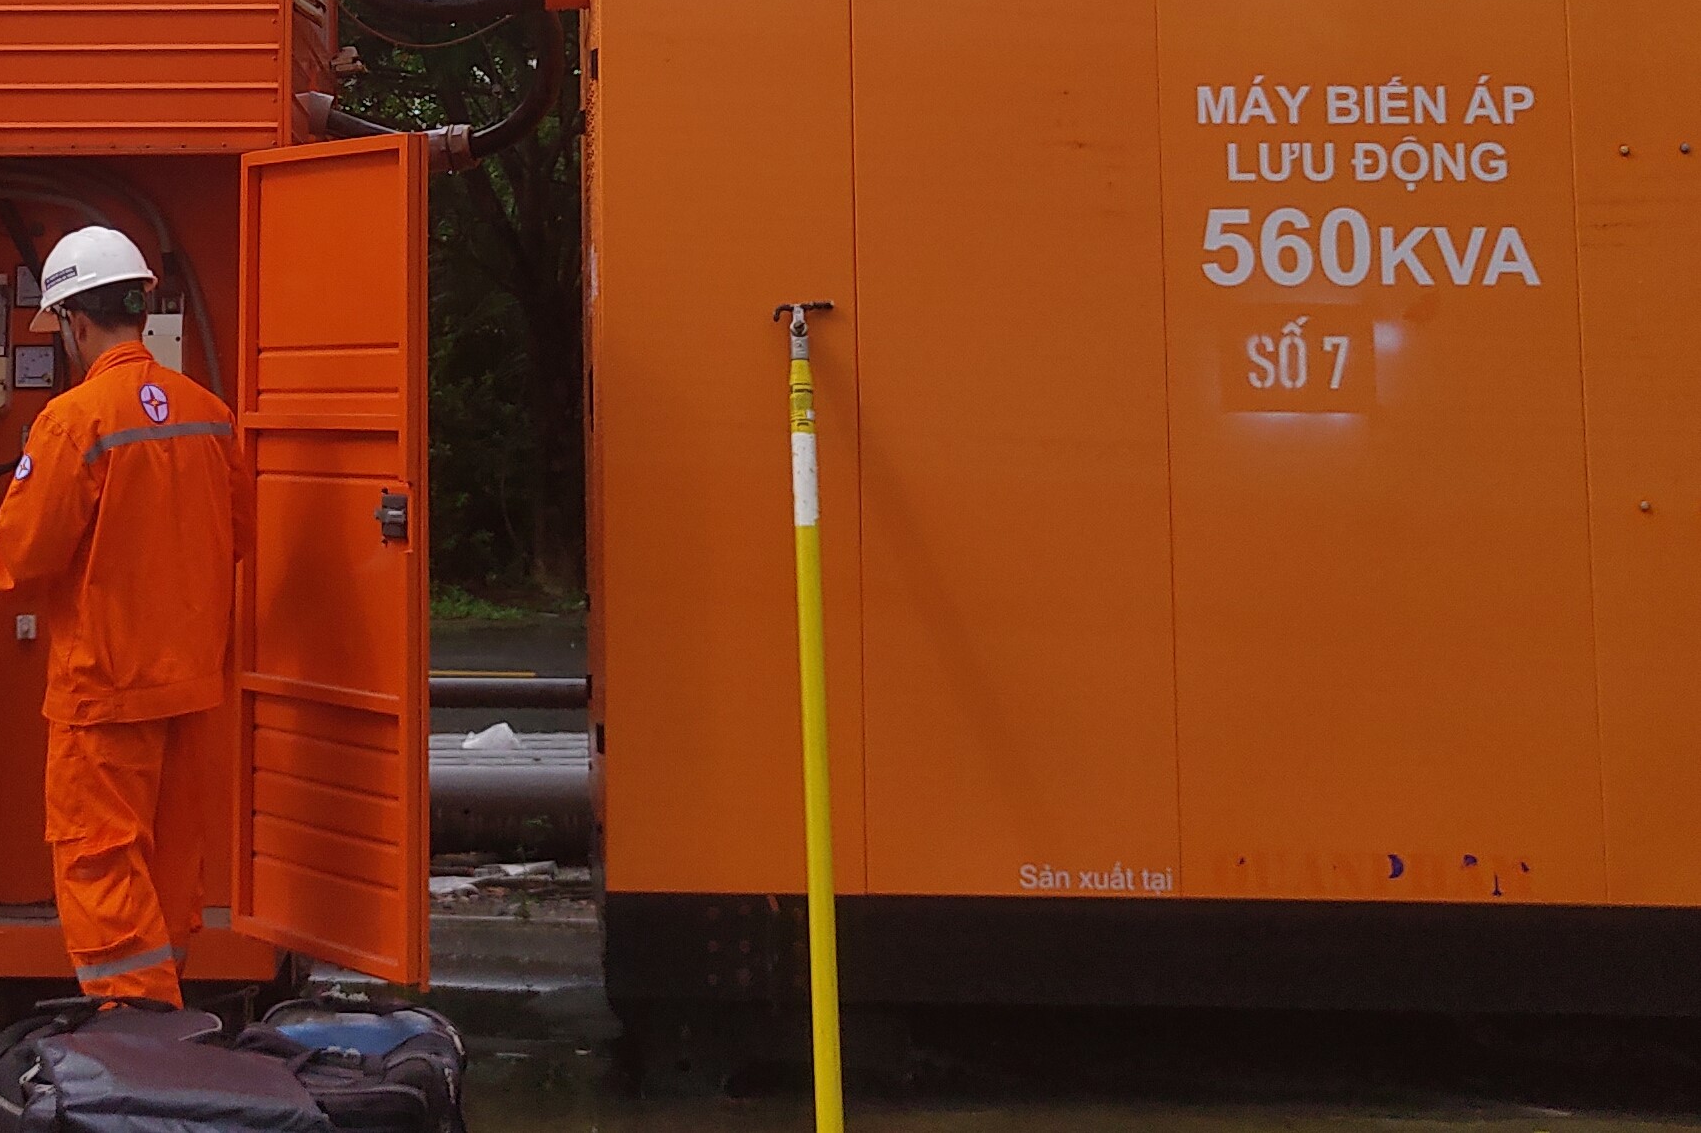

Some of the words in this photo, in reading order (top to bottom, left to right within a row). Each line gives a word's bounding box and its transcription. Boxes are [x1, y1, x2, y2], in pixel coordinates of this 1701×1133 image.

[1196, 74, 1311, 124] MÁY
[1326, 75, 1447, 124] BIẾN
[1463, 74, 1536, 124] ÁP
[1227, 142, 1335, 182] LƯU
[1350, 135, 1508, 192] ĐỘNG
[1246, 316, 1310, 389] SỐ
[1322, 335, 1350, 389] 7
[1019, 864, 1070, 889] Sản
[1078, 861, 1134, 890] xuất
[1141, 866, 1173, 895] tại
